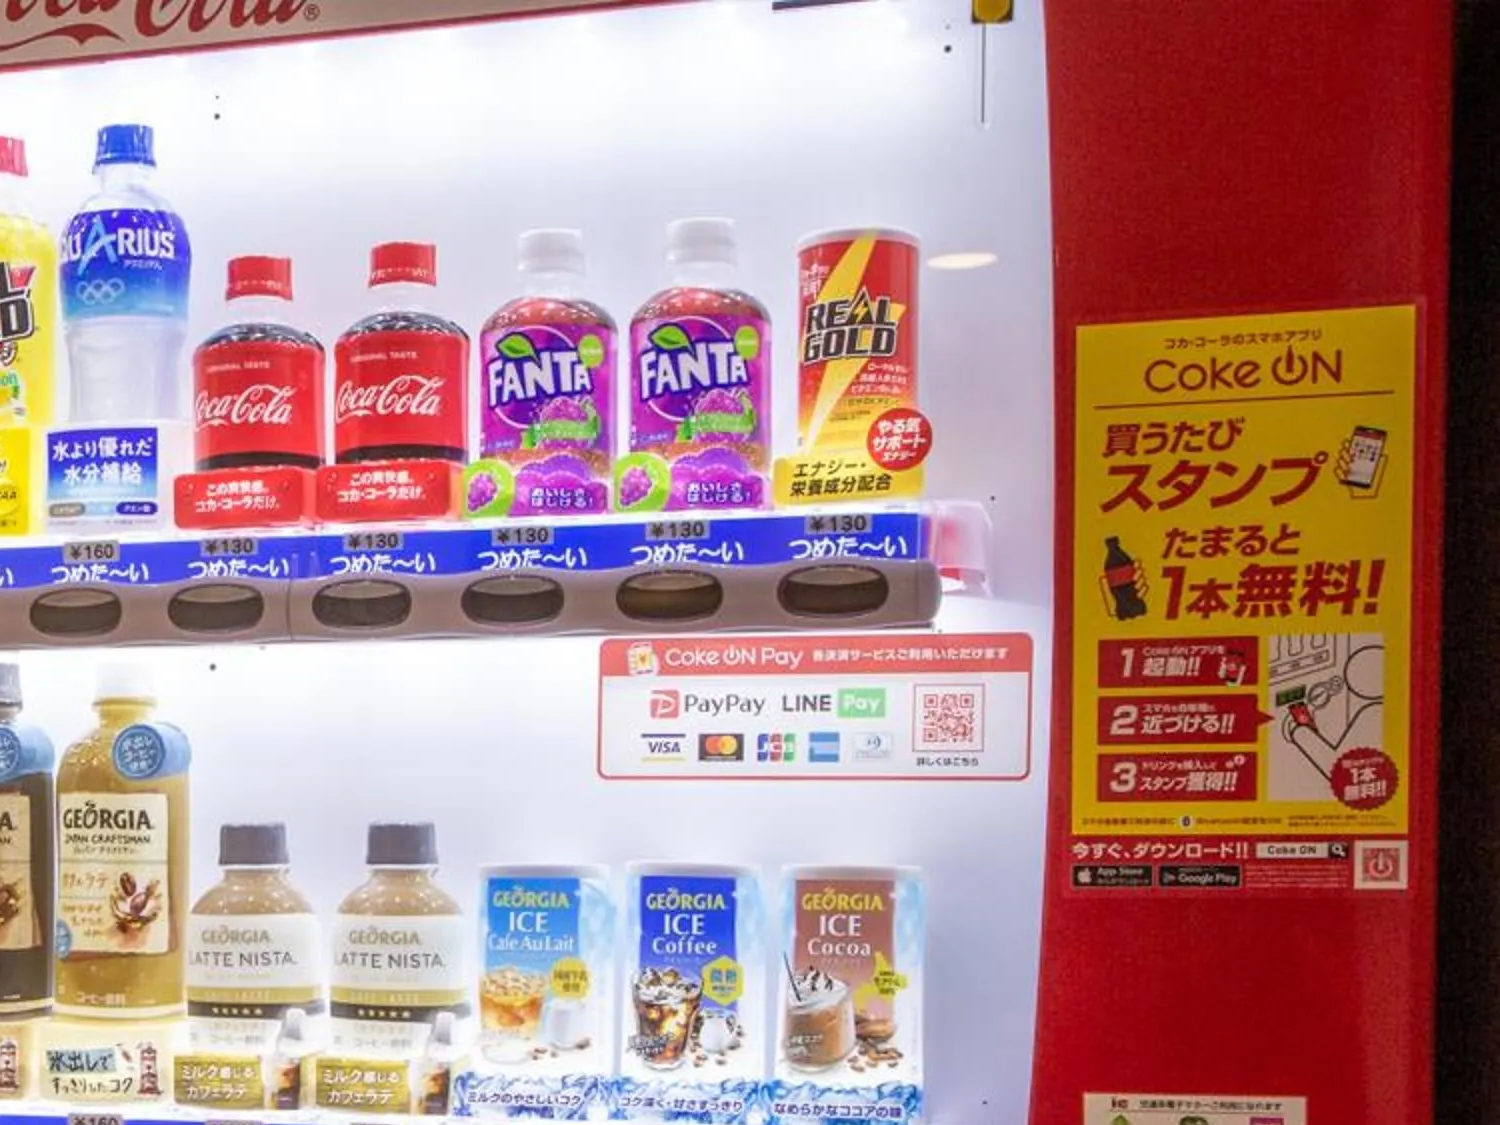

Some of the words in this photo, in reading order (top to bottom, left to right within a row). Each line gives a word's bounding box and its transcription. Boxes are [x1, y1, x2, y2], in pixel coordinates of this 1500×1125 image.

[806, 288, 899, 333] REAL
[802, 325, 897, 364] GOLD
[488, 343, 592, 408] FANTA
[640, 334, 748, 399] FANTA
[1144, 356, 1261, 393] Coke
[1271, 345, 1343, 386] ON
[336, 375, 445, 424] Coca-Cola
[1101, 415, 1246, 458] 買うたび
[789, 473, 894, 497] 栄養成分配合
[1099, 450, 1329, 514] スタンプ
[650, 521, 706, 538] ¥130
[810, 514, 868, 532] ¥130
[205, 538, 255, 555] ¥130
[348, 533, 399, 550] ¥130
[496, 527, 550, 544] ¥130
[1160, 523, 1301, 560] たまると
[68, 544, 115, 560] ¥160
[1160, 558, 1386, 621] 1本無料!
[665, 648, 721, 667] Coke
[724, 642, 757, 665] ON
[761, 645, 804, 670] Pay
[1120, 648, 1135, 678] 1
[684, 693, 766, 718] PayPay
[781, 693, 832, 712] LINE
[842, 694, 883, 716] Pay
[1109, 704, 1139, 736] 2
[647, 740, 682, 753] VISA
[1109, 761, 1138, 793] 3
[62, 800, 152, 830] GEORGIA
[492, 887, 570, 910] GEORGIA
[645, 887, 727, 911] GEORGIA
[801, 887, 884, 912] GEORGIA
[201, 924, 271, 944] GEORGIA
[508, 911, 549, 934] ICE
[663, 914, 706, 935] ICE
[818, 914, 863, 937] ICE
[348, 925, 421, 946] GEORGIA
[652, 935, 718, 955] Coffee
[807, 939, 872, 957] Cocoa
